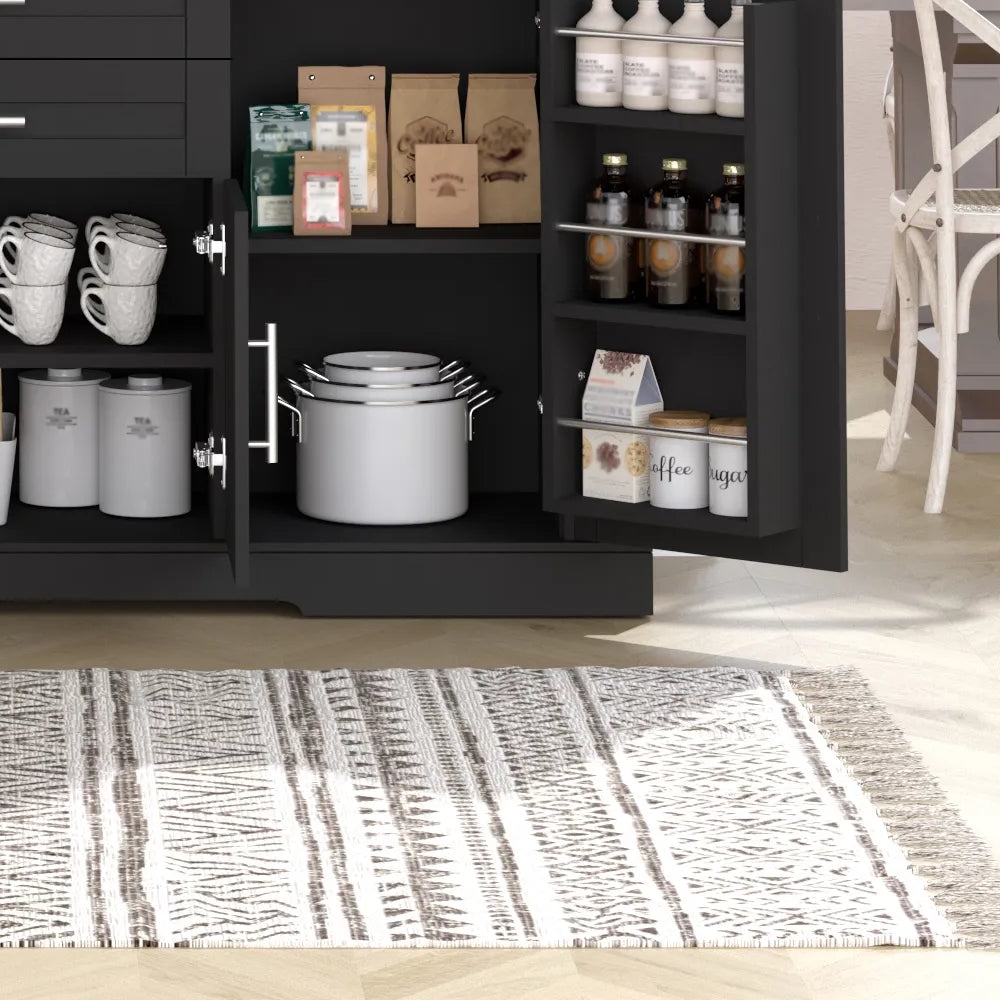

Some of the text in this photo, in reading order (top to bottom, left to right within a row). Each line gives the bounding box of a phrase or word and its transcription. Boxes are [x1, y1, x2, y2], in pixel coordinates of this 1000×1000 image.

[53, 408, 70, 416] TEA
[134, 417, 151, 425] TEA
[650, 455, 693, 482] offee
